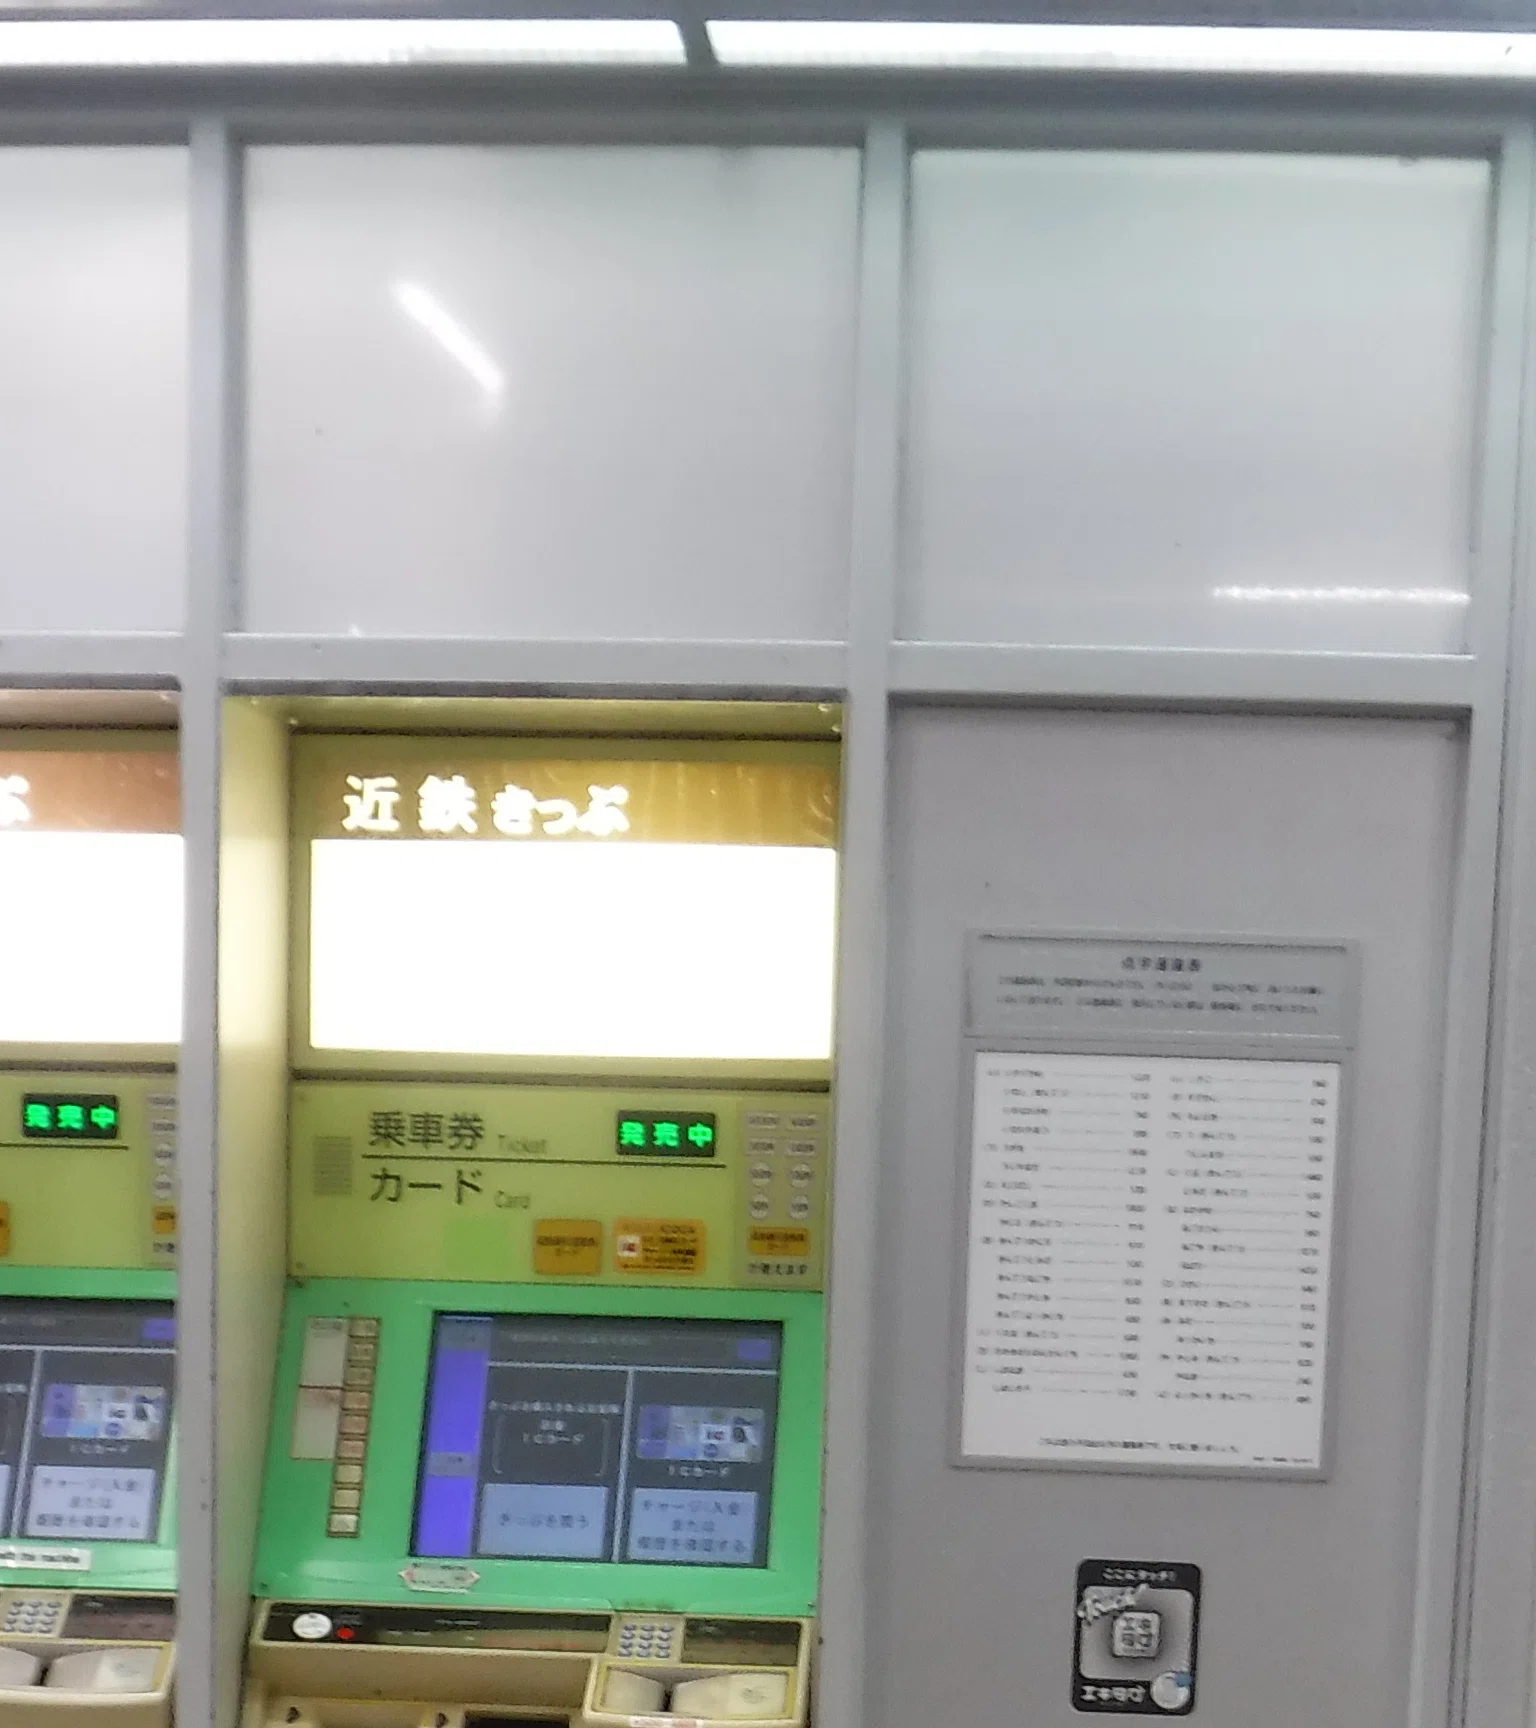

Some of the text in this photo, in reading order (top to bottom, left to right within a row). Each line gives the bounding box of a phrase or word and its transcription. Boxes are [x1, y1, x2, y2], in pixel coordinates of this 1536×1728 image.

[368, 1110, 549, 1155] 乗車券 Ticket
[618, 1121, 714, 1149] 発売中
[370, 1168, 532, 1211] カード Card
